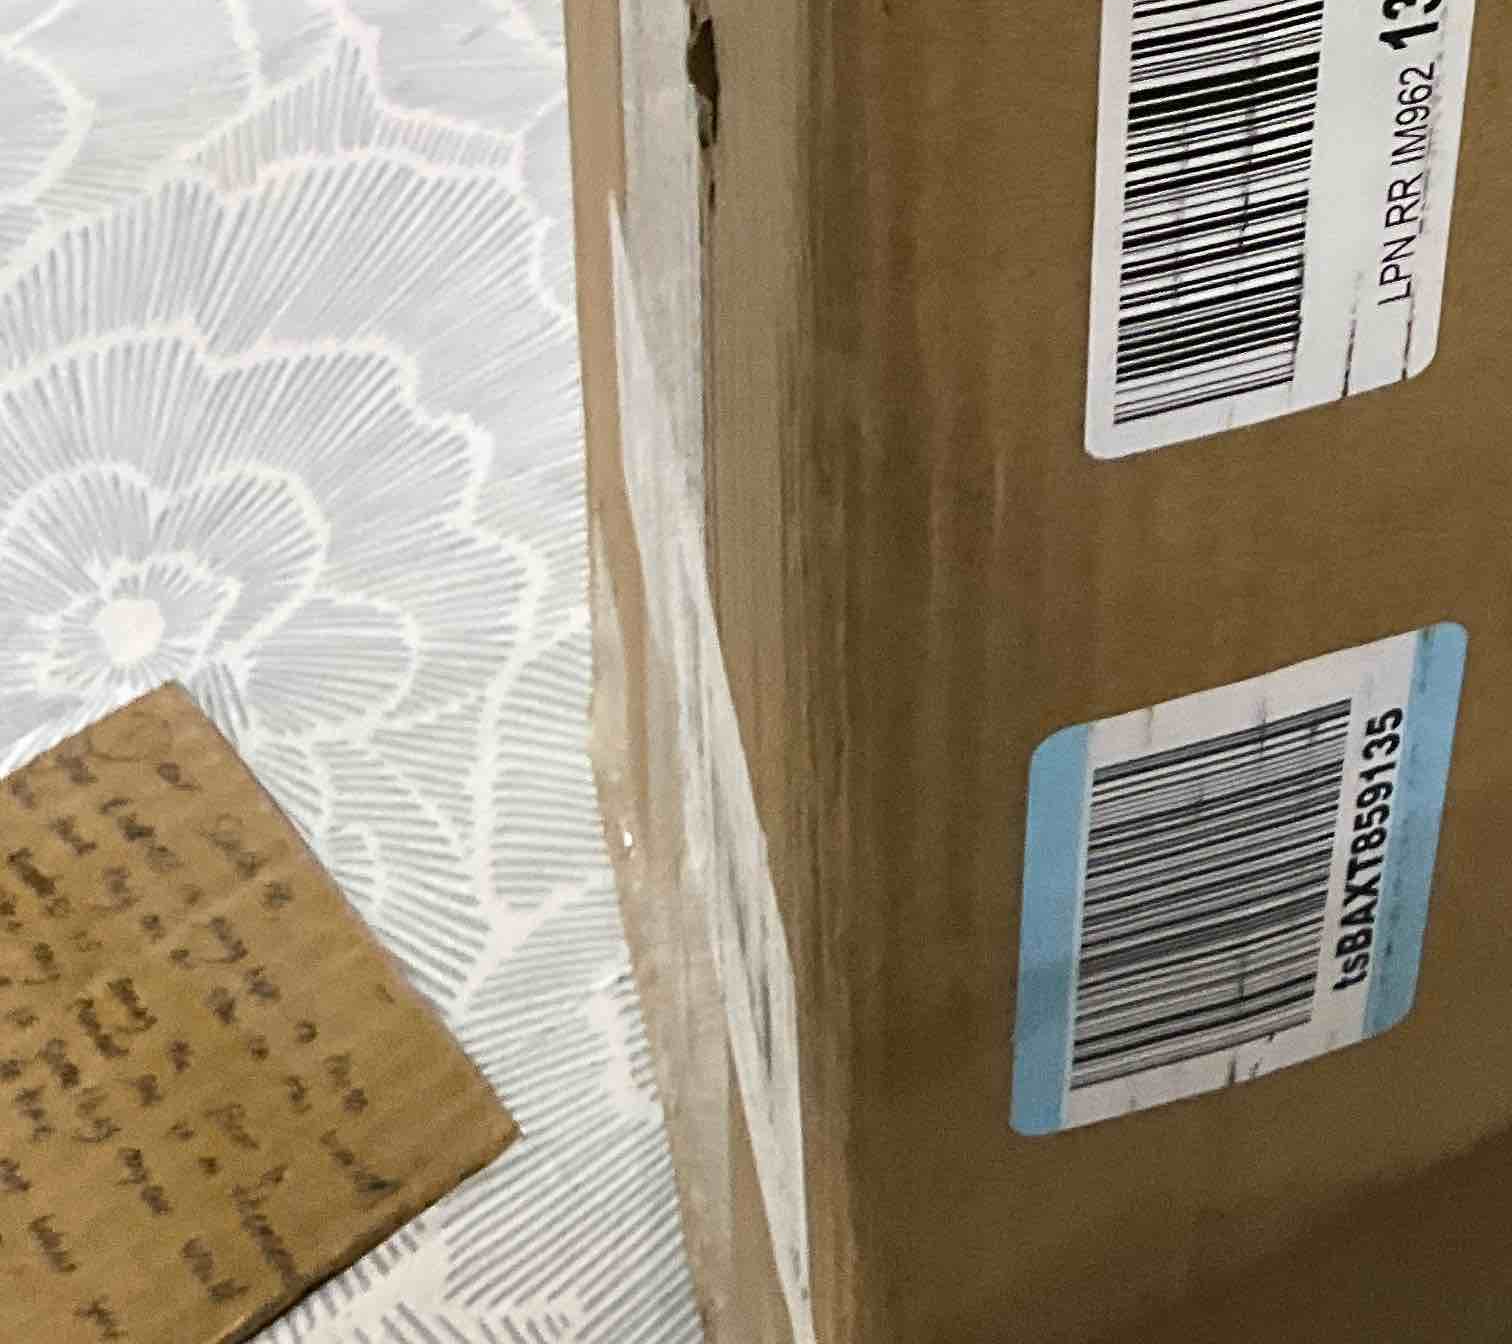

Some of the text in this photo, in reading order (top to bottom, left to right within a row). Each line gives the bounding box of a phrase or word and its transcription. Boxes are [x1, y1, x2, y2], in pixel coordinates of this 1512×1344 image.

[1391, 62, 1435, 166] IM962
[1384, 173, 1422, 228] RR
[1377, 236, 1416, 305] LPN
[1332, 708, 1403, 991] tsBAXT859135
